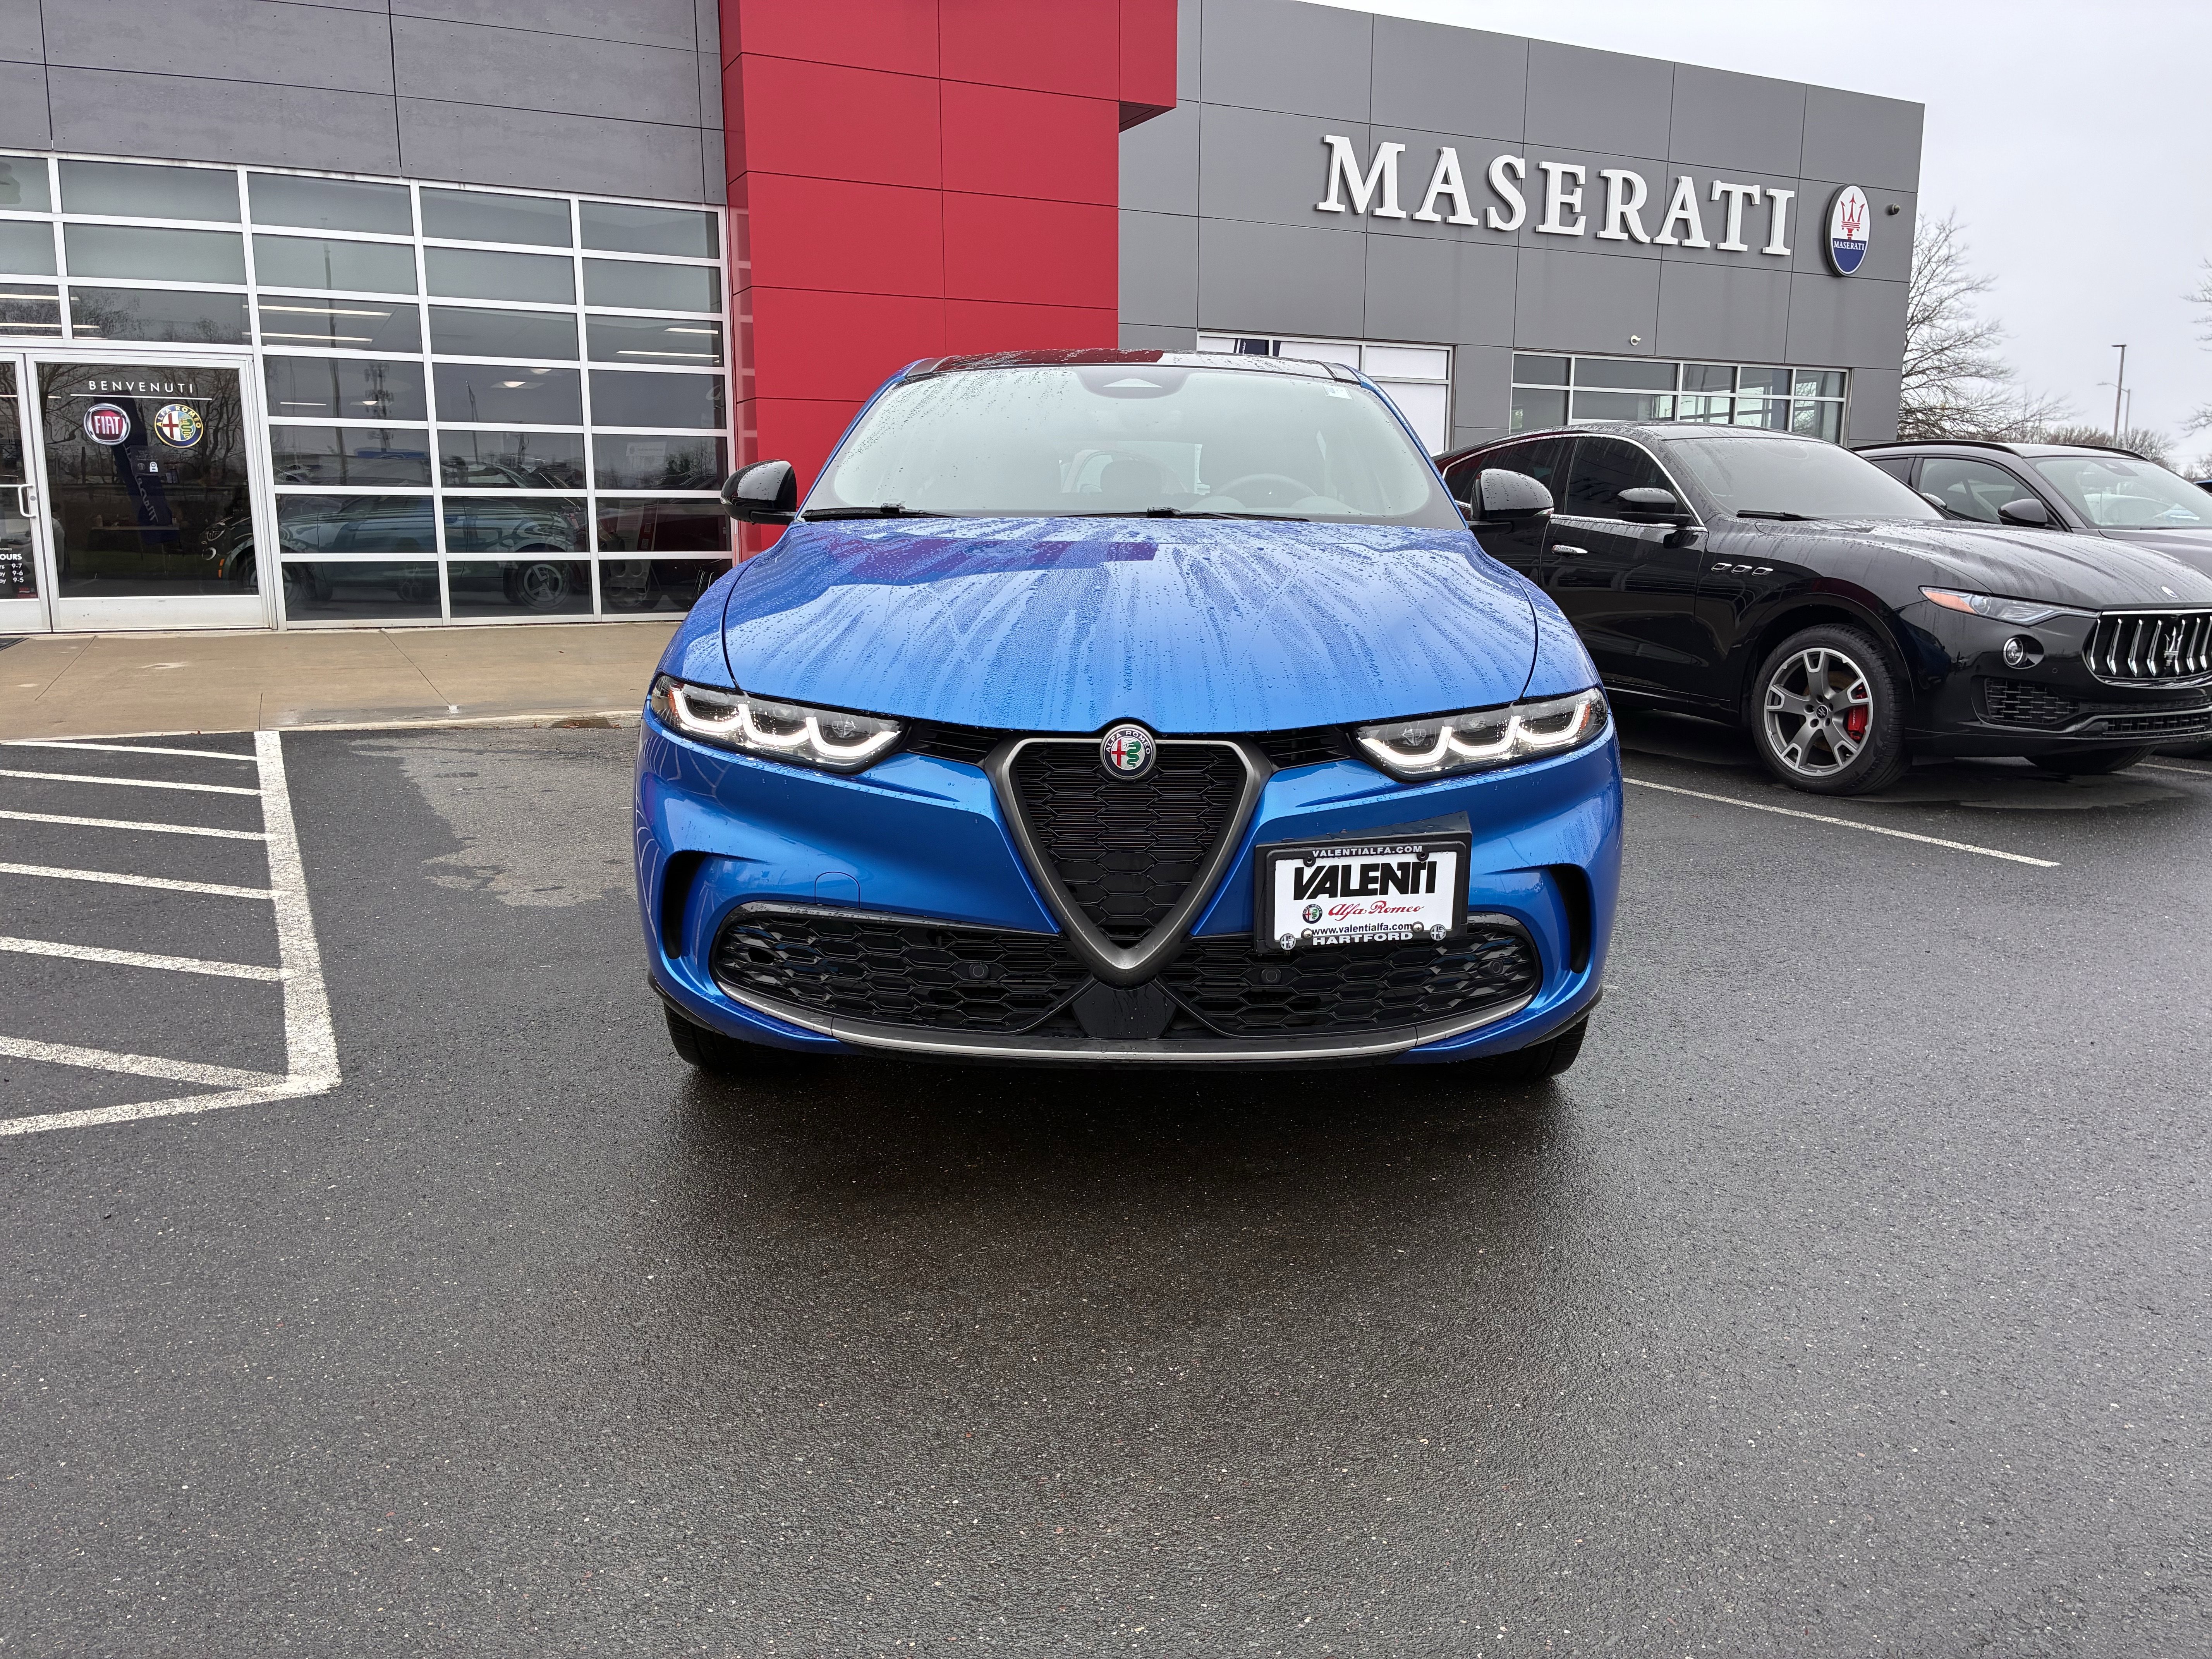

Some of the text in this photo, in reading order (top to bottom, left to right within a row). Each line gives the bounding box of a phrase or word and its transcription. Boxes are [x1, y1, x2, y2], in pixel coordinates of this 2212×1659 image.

[1316, 134, 1795, 256] MASERATI
[1834, 240, 1864, 250] MASERATI
[89, 381, 193, 393] BENVENUTI
[94, 416, 120, 434] FIAT
[156, 405, 202, 429] ALFA ROMEO
[1106, 730, 1151, 754] ALFA ROMEO
[1312, 845, 1422, 857] VALENTIALFA.COM
[1293, 861, 1437, 900] VALENTI
[1328, 903, 1367, 921] Alfa
[1368, 900, 1425, 914] Romeo
[1312, 922, 1412, 936] www.valentialfa.com
[1313, 932, 1413, 946] HARTFORD
